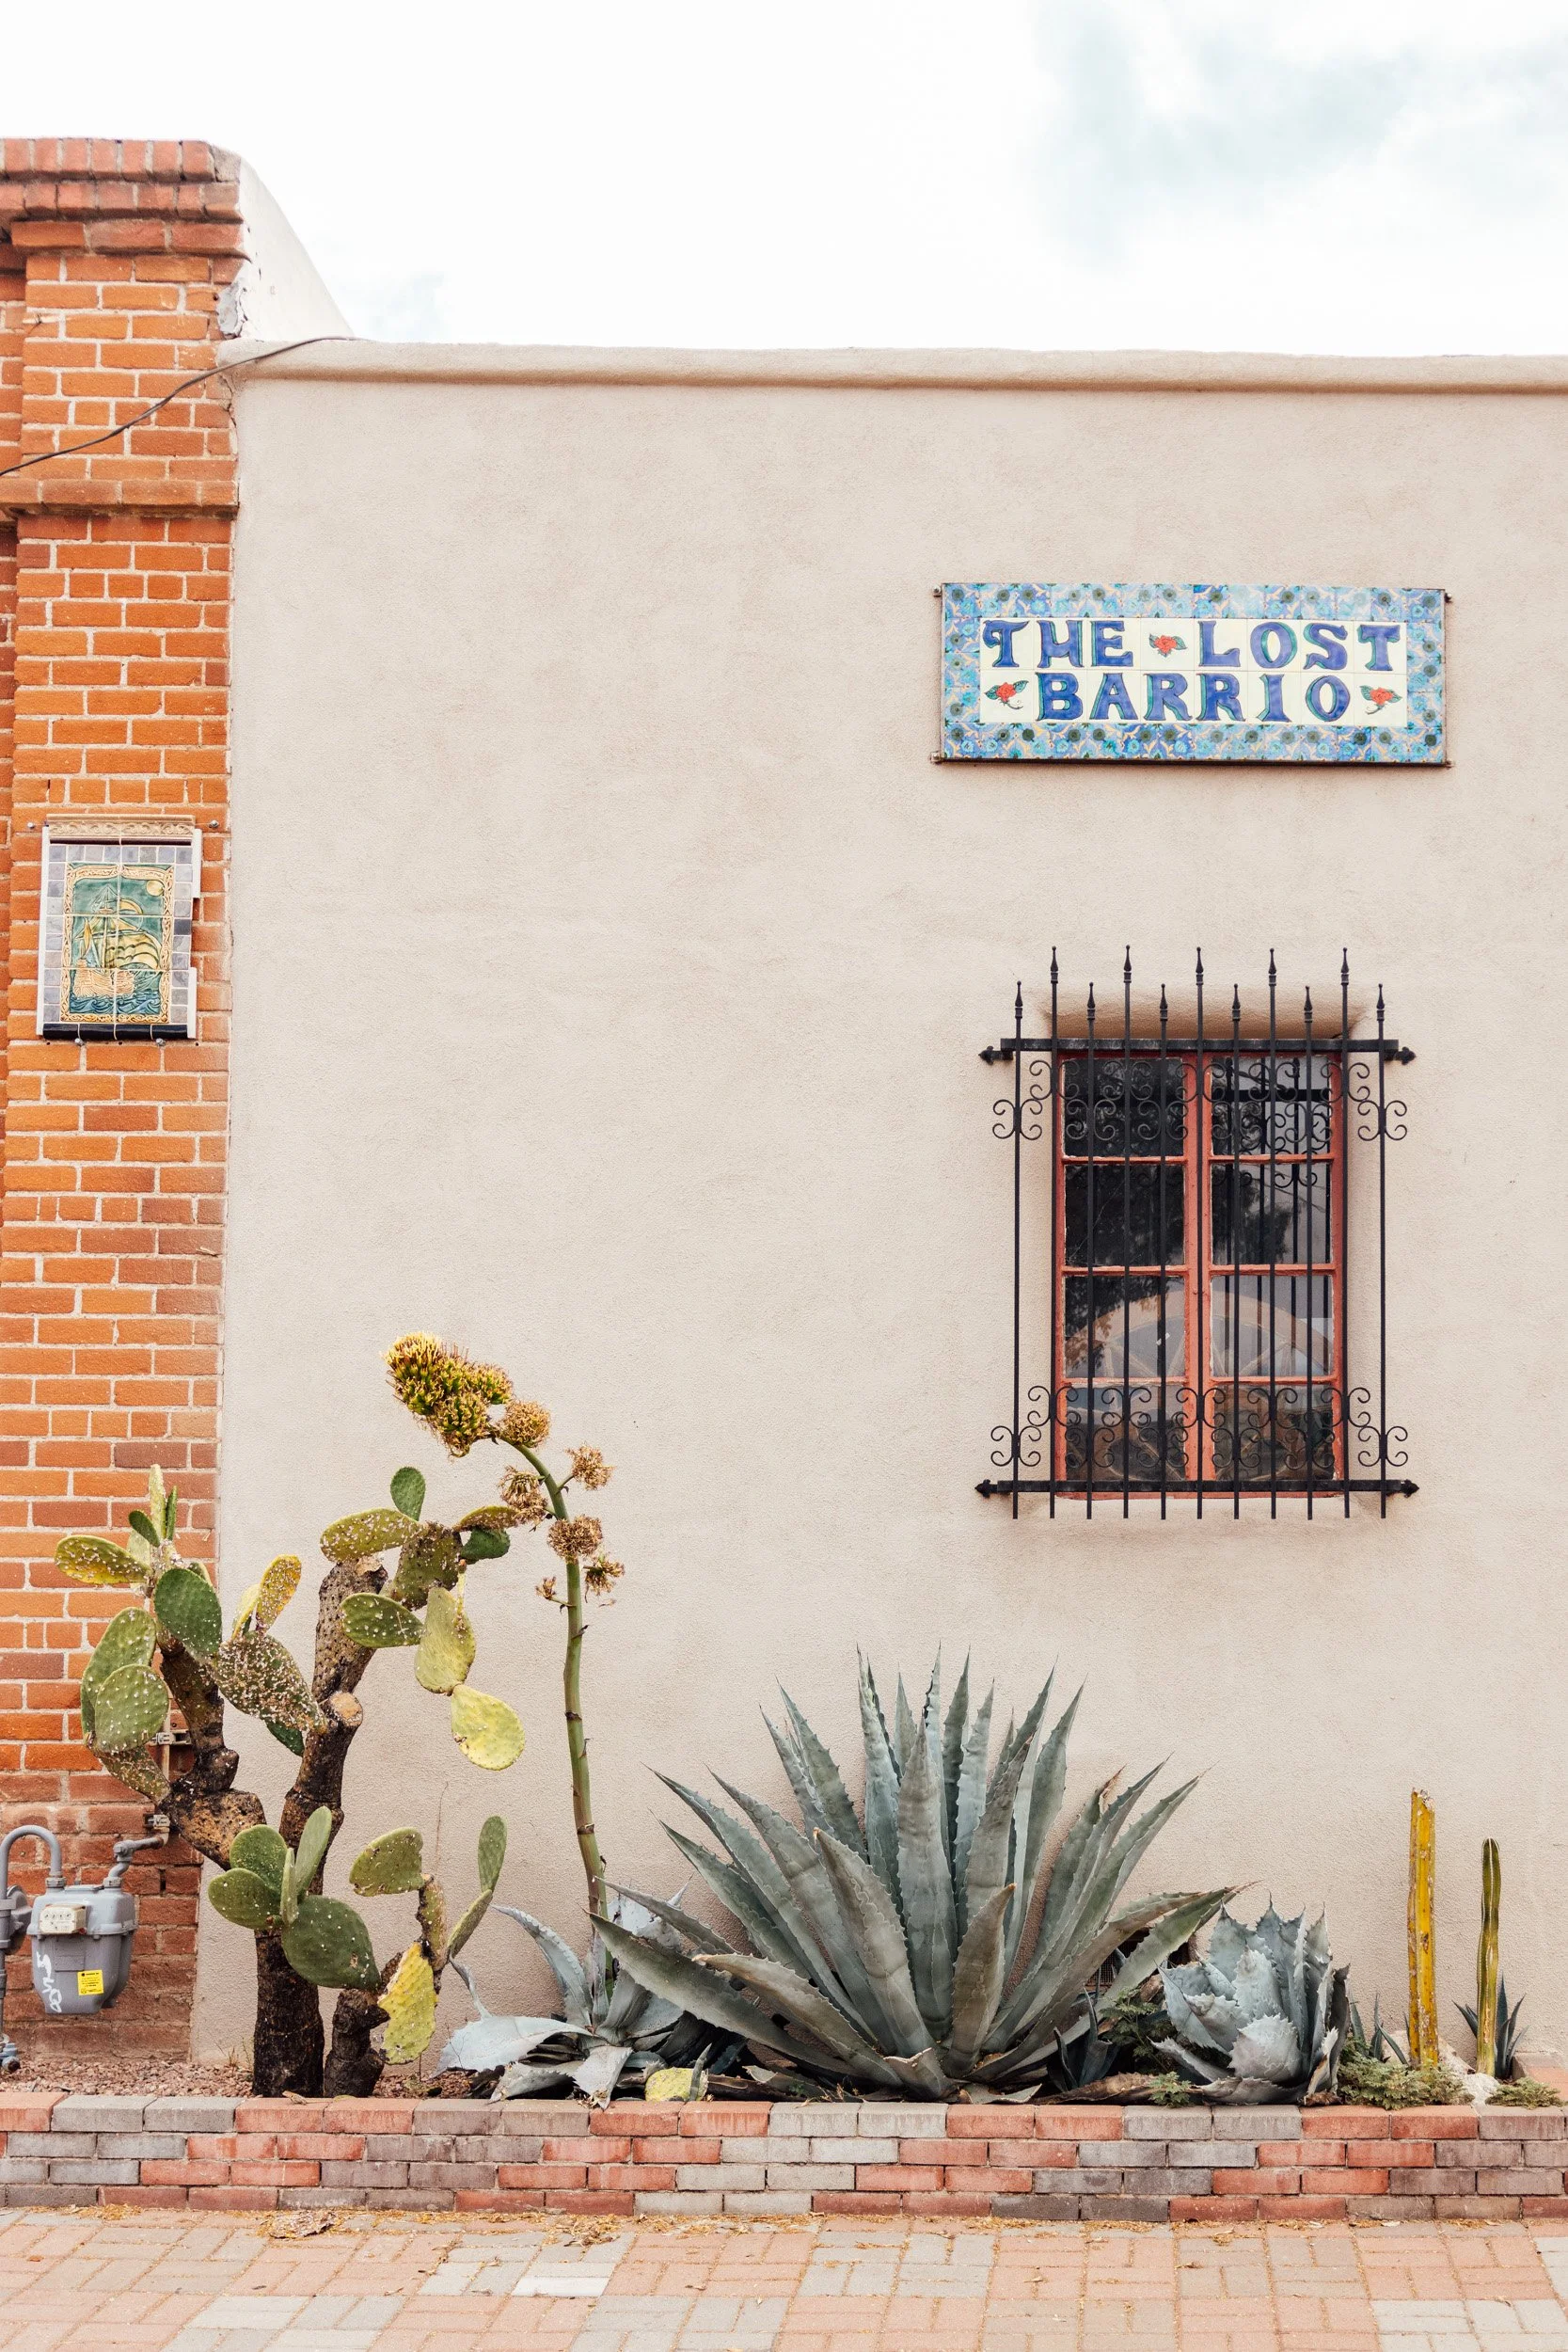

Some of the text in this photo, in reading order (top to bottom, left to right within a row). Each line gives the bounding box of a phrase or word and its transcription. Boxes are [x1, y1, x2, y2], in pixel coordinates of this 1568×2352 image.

[982, 619, 1402, 671] THE LOST
[1035, 672, 1352, 723] BARRIO
